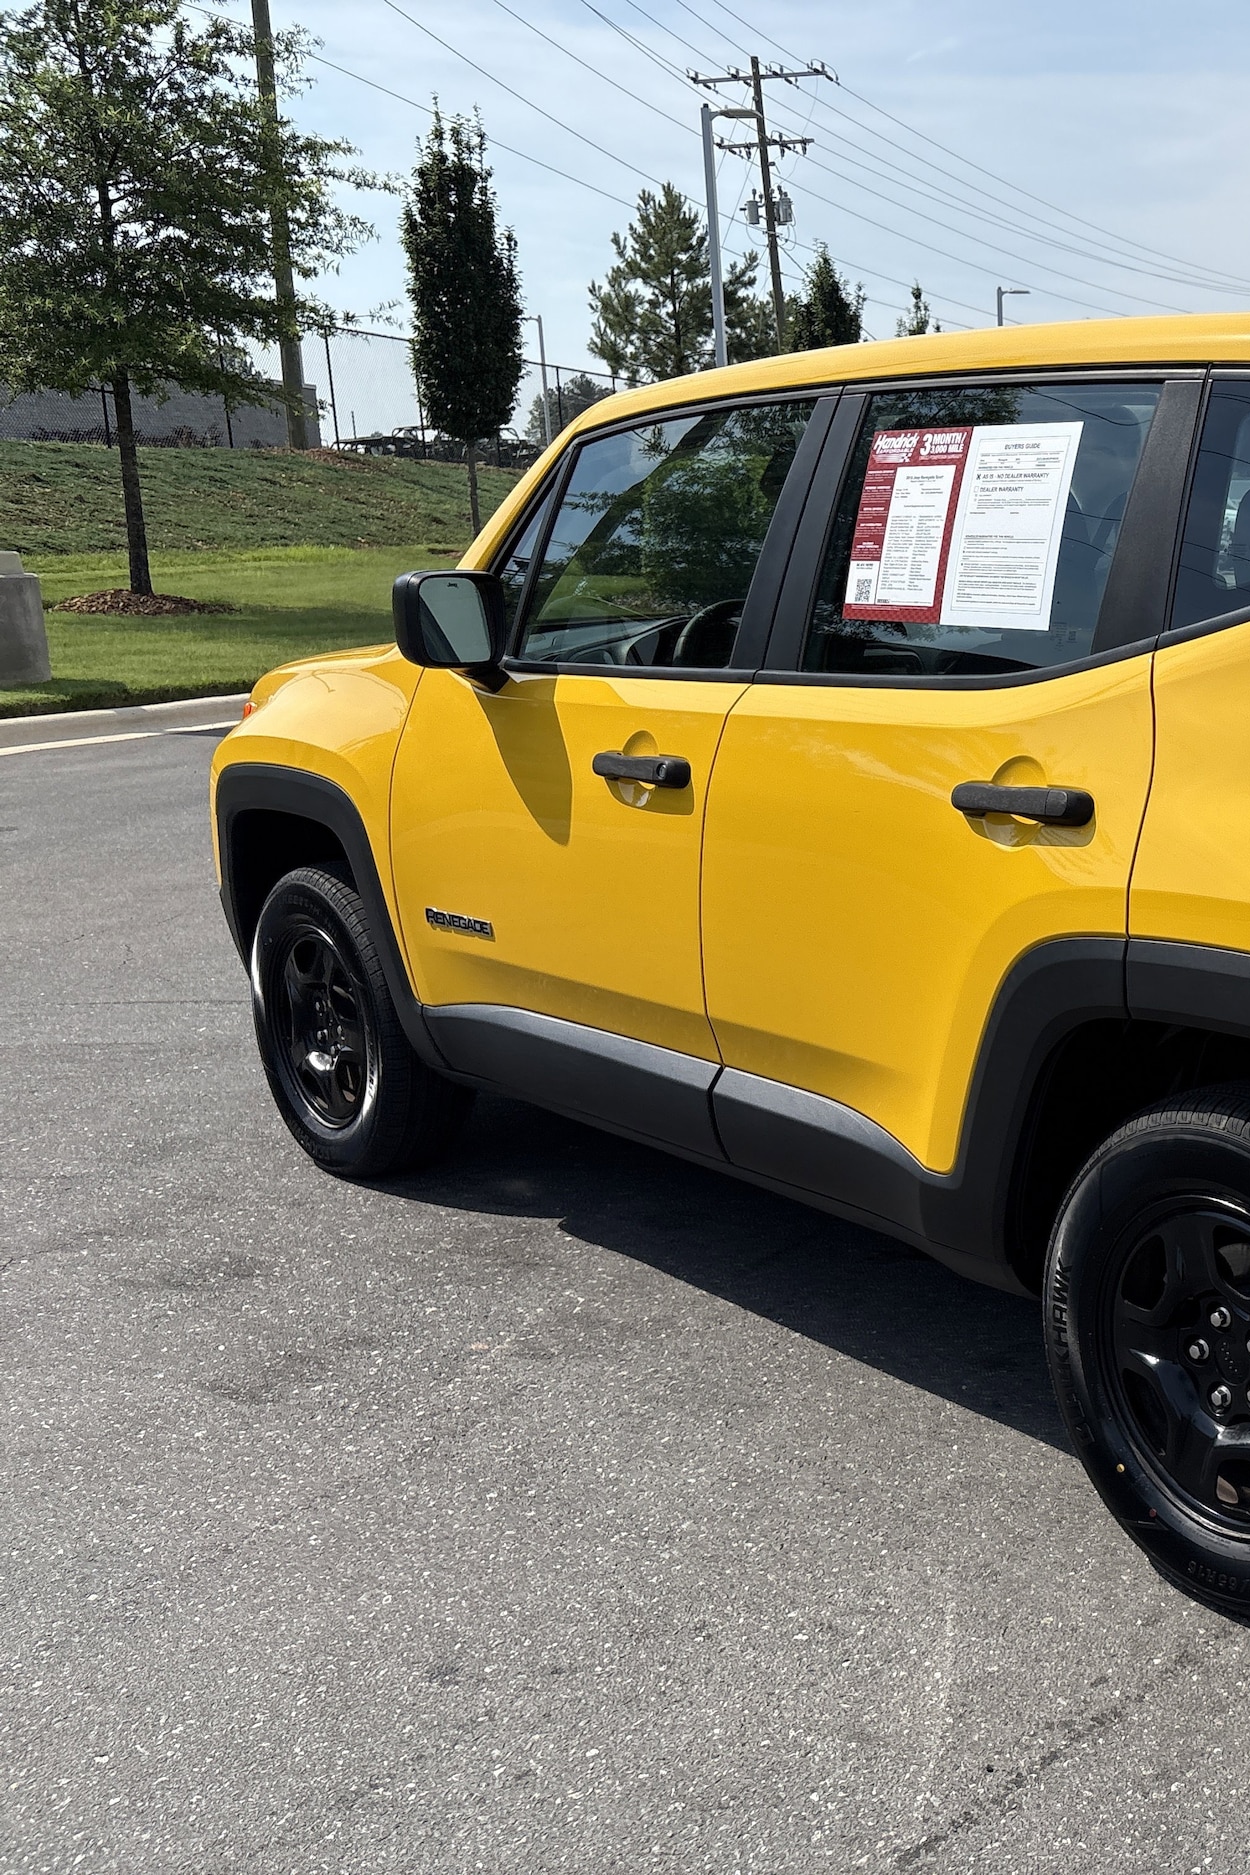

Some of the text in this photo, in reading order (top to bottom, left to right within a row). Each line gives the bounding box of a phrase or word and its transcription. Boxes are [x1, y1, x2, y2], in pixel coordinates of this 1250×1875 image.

[873, 432, 920, 454] Hendrick
[919, 433, 933, 456] 3
[947, 443, 964, 453] MILE
[426, 906, 492, 936] RENEGADE
